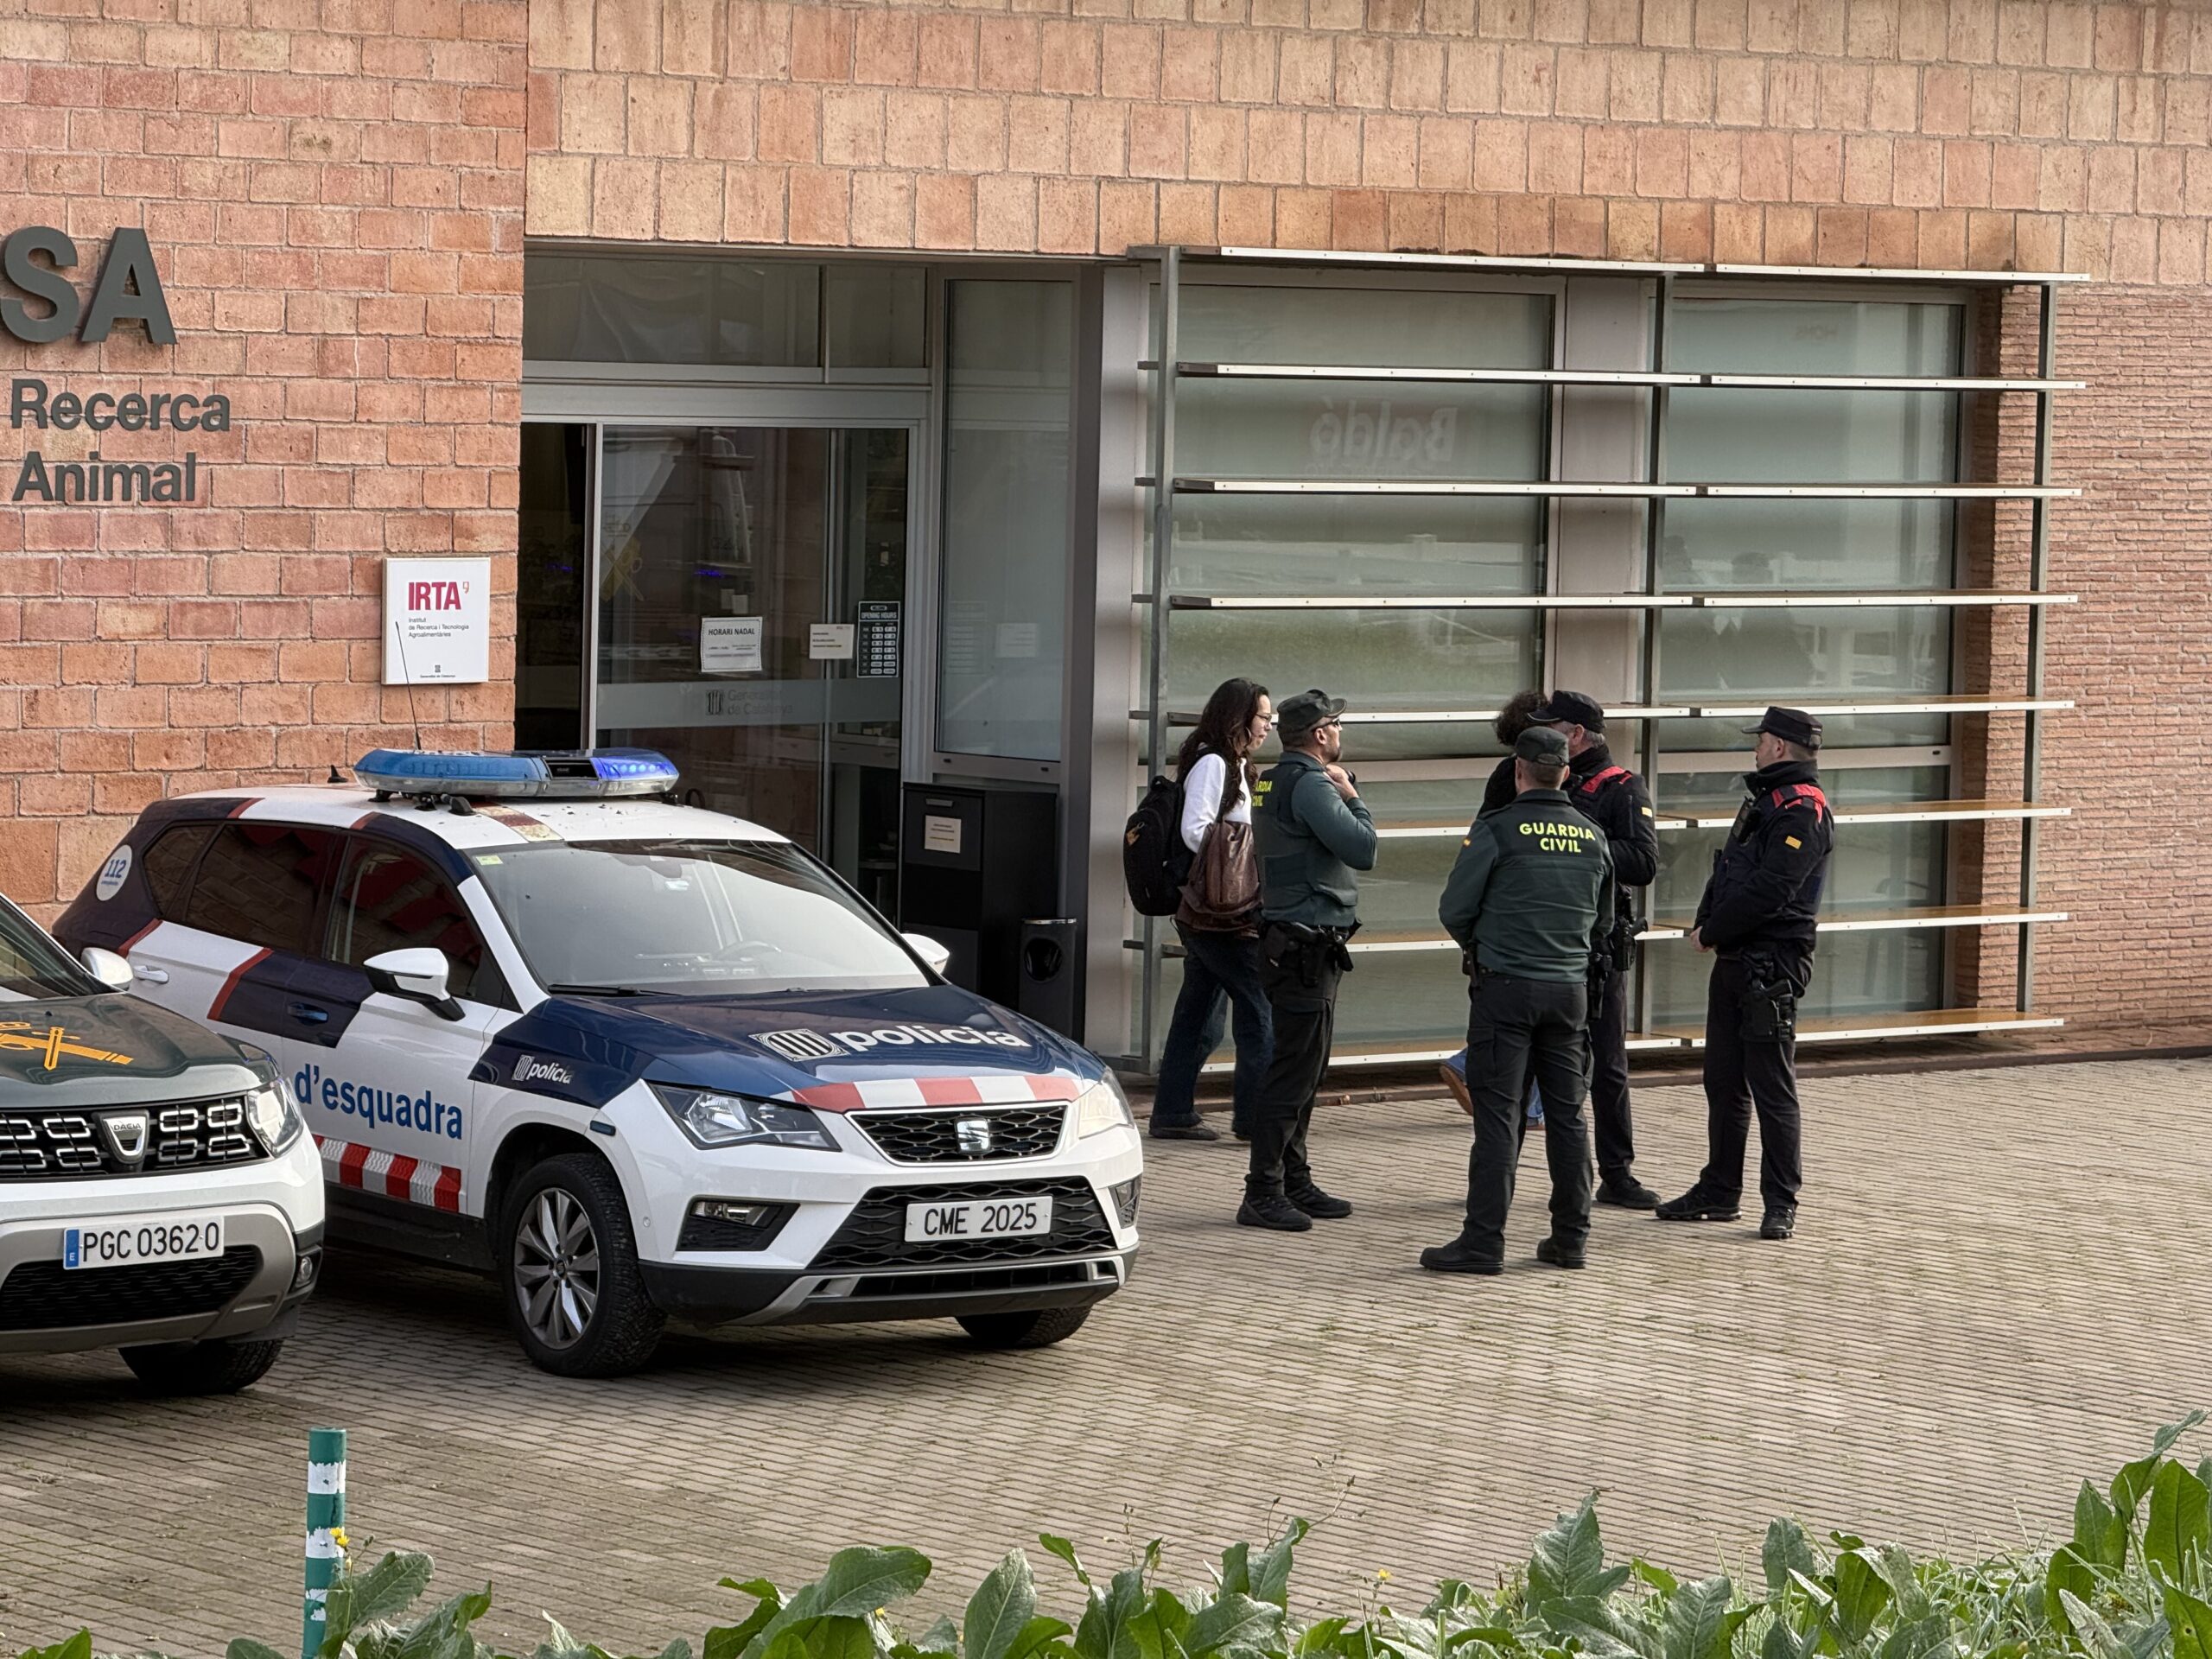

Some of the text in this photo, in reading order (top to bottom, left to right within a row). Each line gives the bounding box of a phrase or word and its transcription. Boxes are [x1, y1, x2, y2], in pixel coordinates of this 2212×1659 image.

[0, 226, 177, 345] SA
[11, 378, 231, 431] Recerca
[12, 451, 196, 501] Animal
[409, 582, 461, 610] IRTA
[1519, 823, 1596, 841] GUARDIA
[1540, 837, 1582, 854] CIVIL
[105, 859, 127, 878] 112
[830, 1025, 1032, 1052] policia
[525, 1062, 572, 1084] policia
[113, 1122, 142, 1131] DACIA
[924, 1203, 1037, 1236] CME 2025
[83, 1230, 131, 1262] PGC
